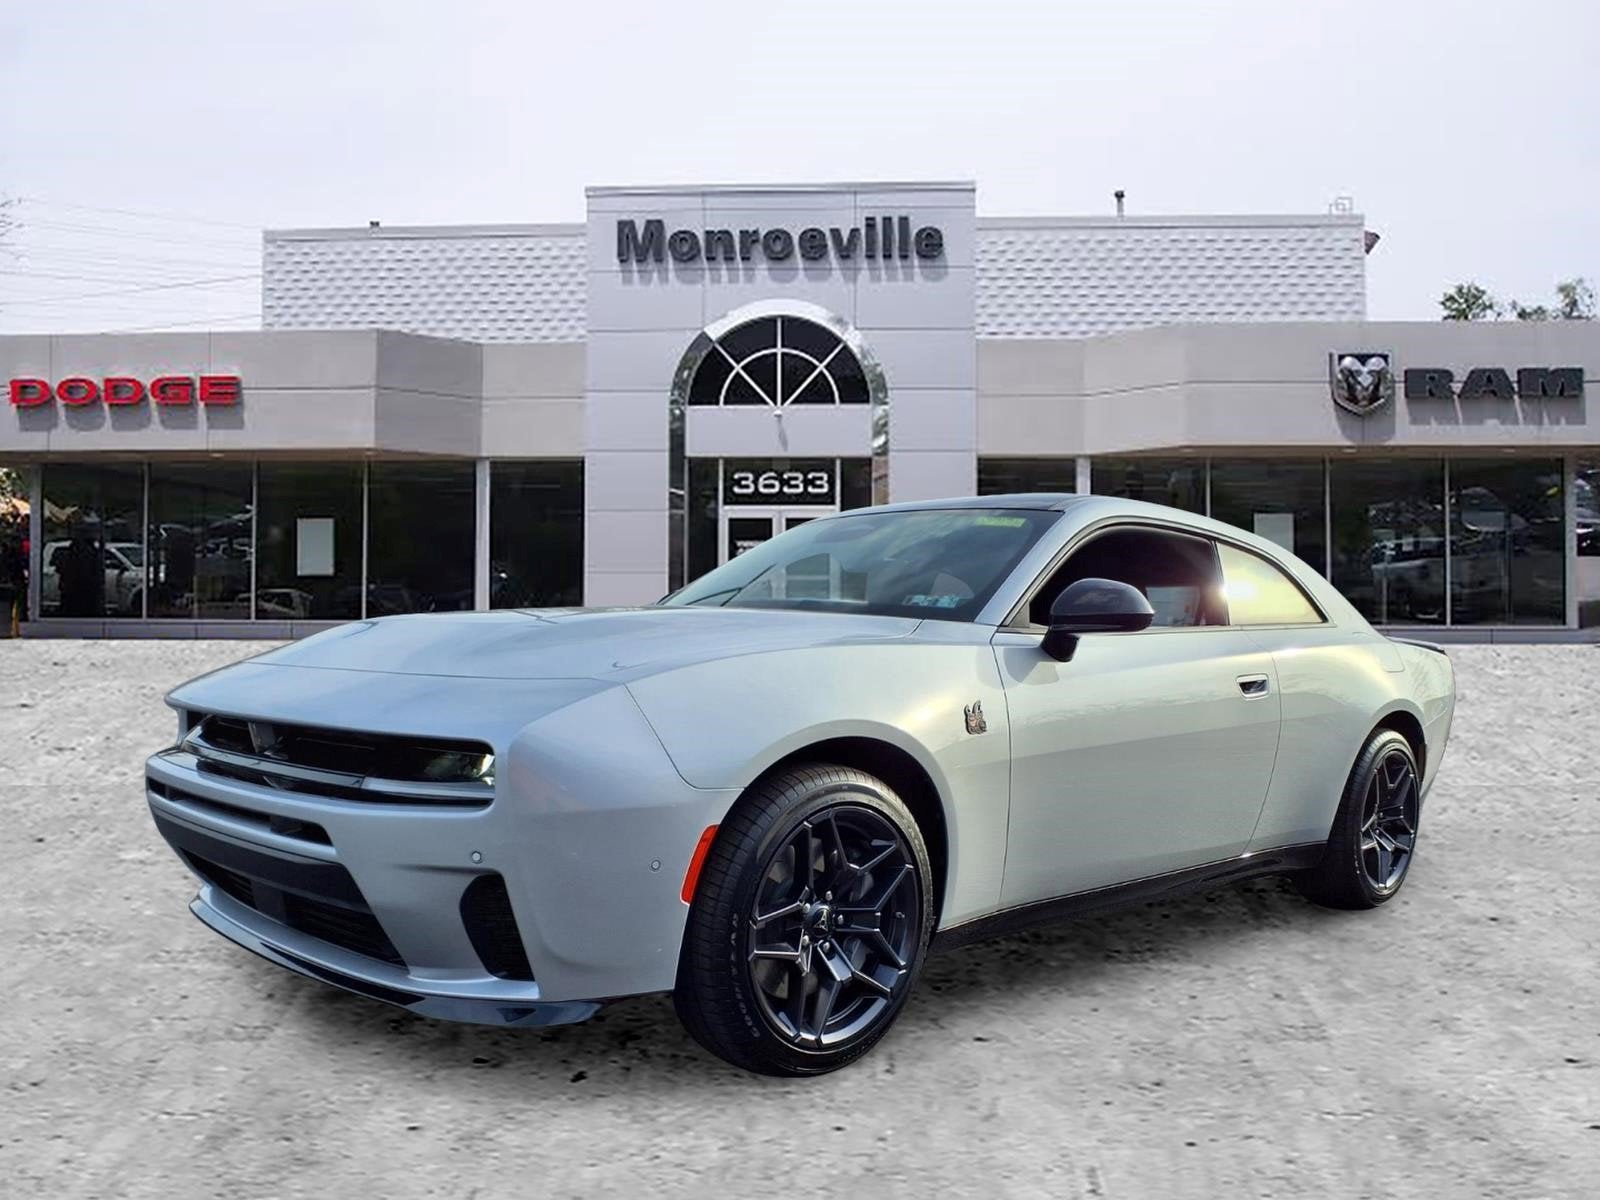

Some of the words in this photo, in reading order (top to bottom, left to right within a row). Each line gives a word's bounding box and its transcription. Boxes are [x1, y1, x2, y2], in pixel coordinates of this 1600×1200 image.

[617, 216, 944, 262] Monroeville
[10, 376, 241, 405] DODGE
[1404, 367, 1584, 398] RAM
[733, 472, 829, 493] 3633
